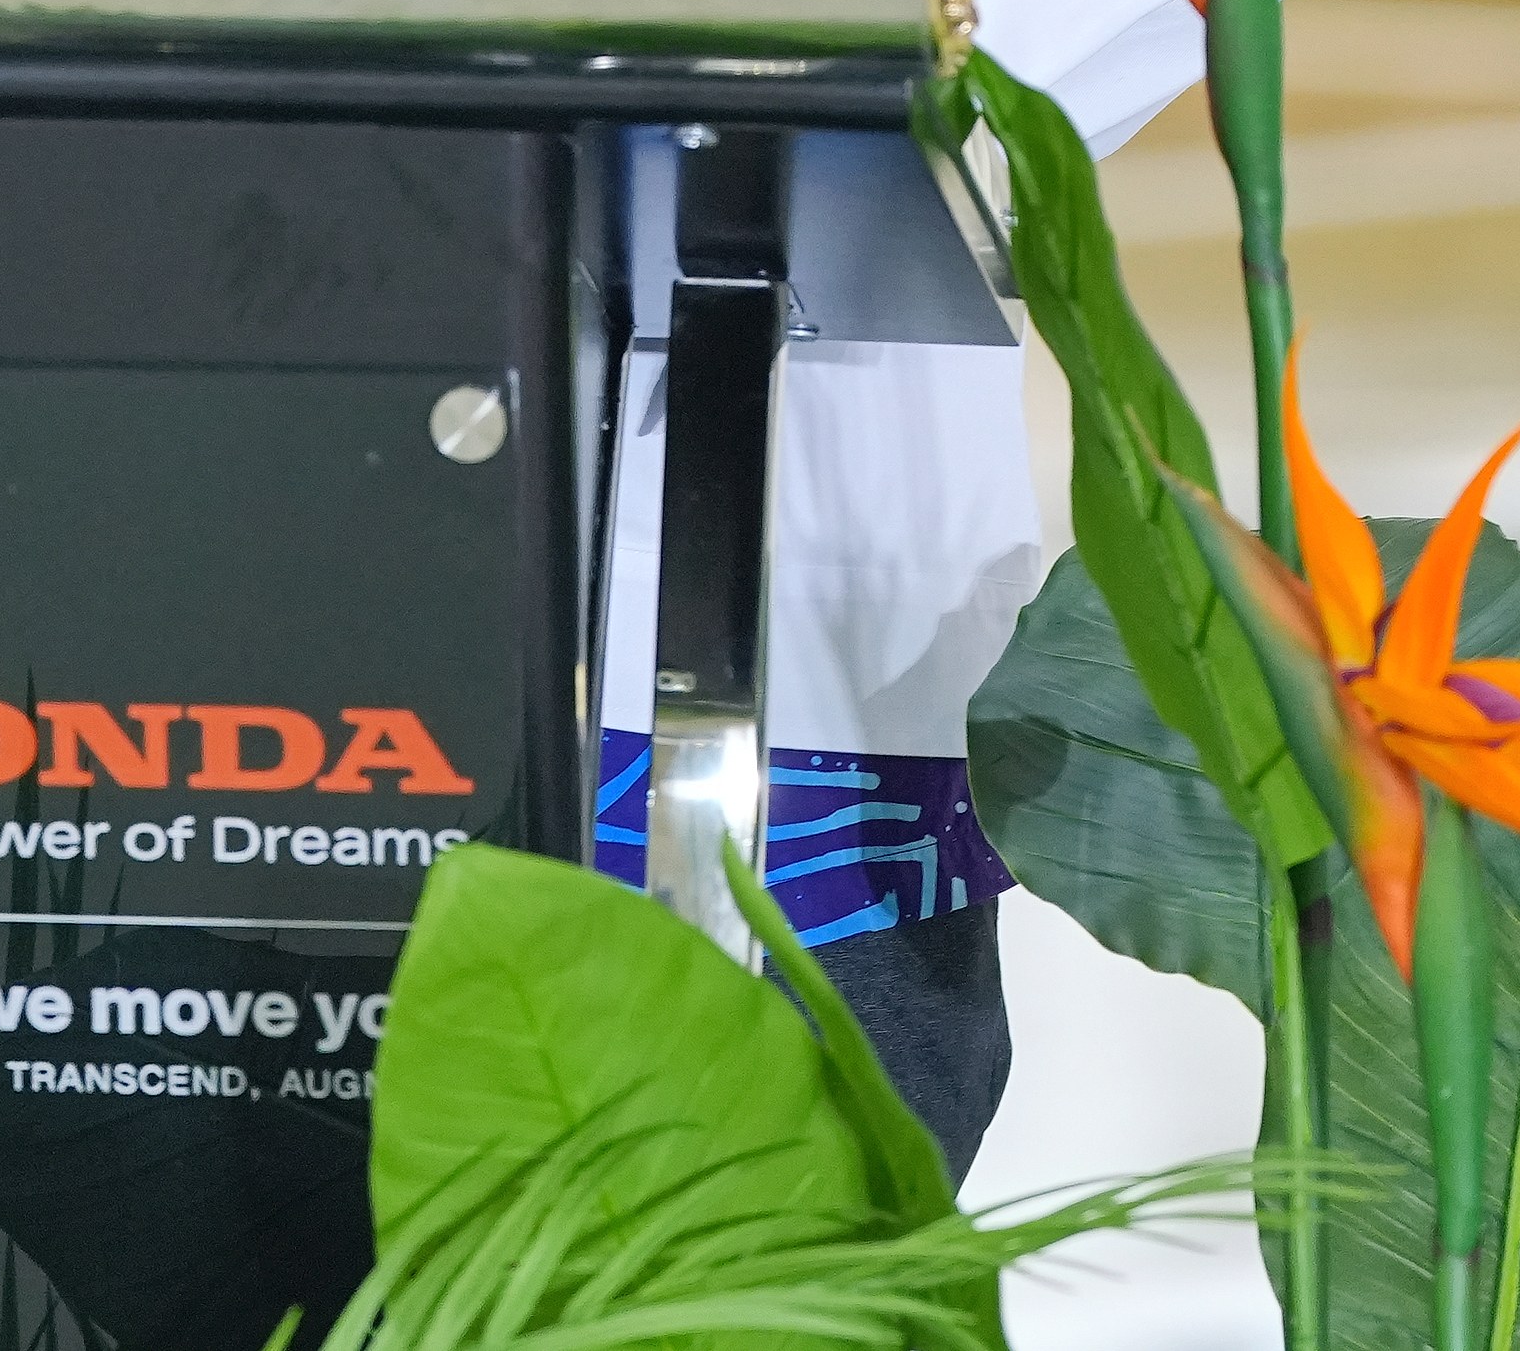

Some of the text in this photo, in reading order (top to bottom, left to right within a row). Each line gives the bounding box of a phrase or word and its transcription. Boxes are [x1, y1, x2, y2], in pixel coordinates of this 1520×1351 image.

[123, 814, 197, 862] of
[90, 986, 298, 1038] move
[4, 1060, 260, 1104] TRANSCEND,
